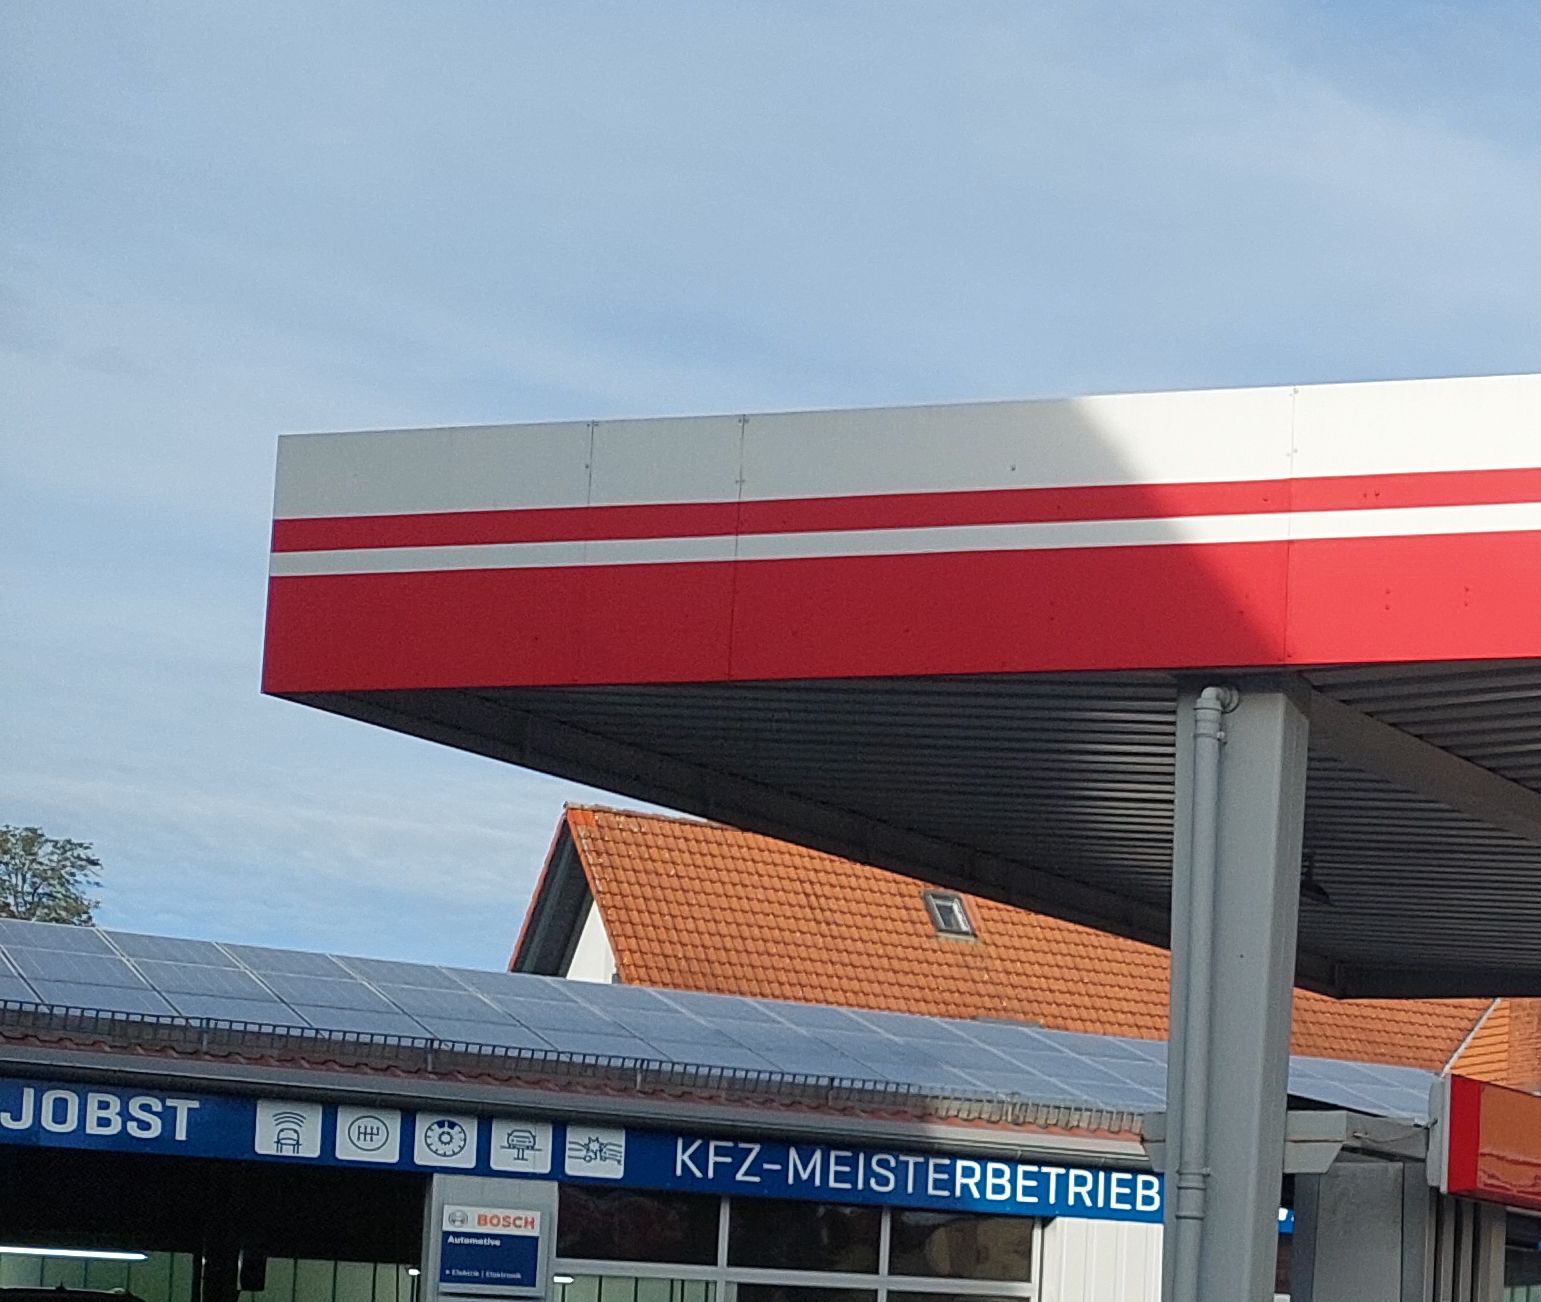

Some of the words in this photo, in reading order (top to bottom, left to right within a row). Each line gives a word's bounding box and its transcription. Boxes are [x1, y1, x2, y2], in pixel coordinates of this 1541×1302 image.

[0, 1087, 200, 1141] JOBST
[675, 1136, 1161, 1212] KFZ-MEISTERBETRIEB
[477, 1213, 536, 1230] BOSCH
